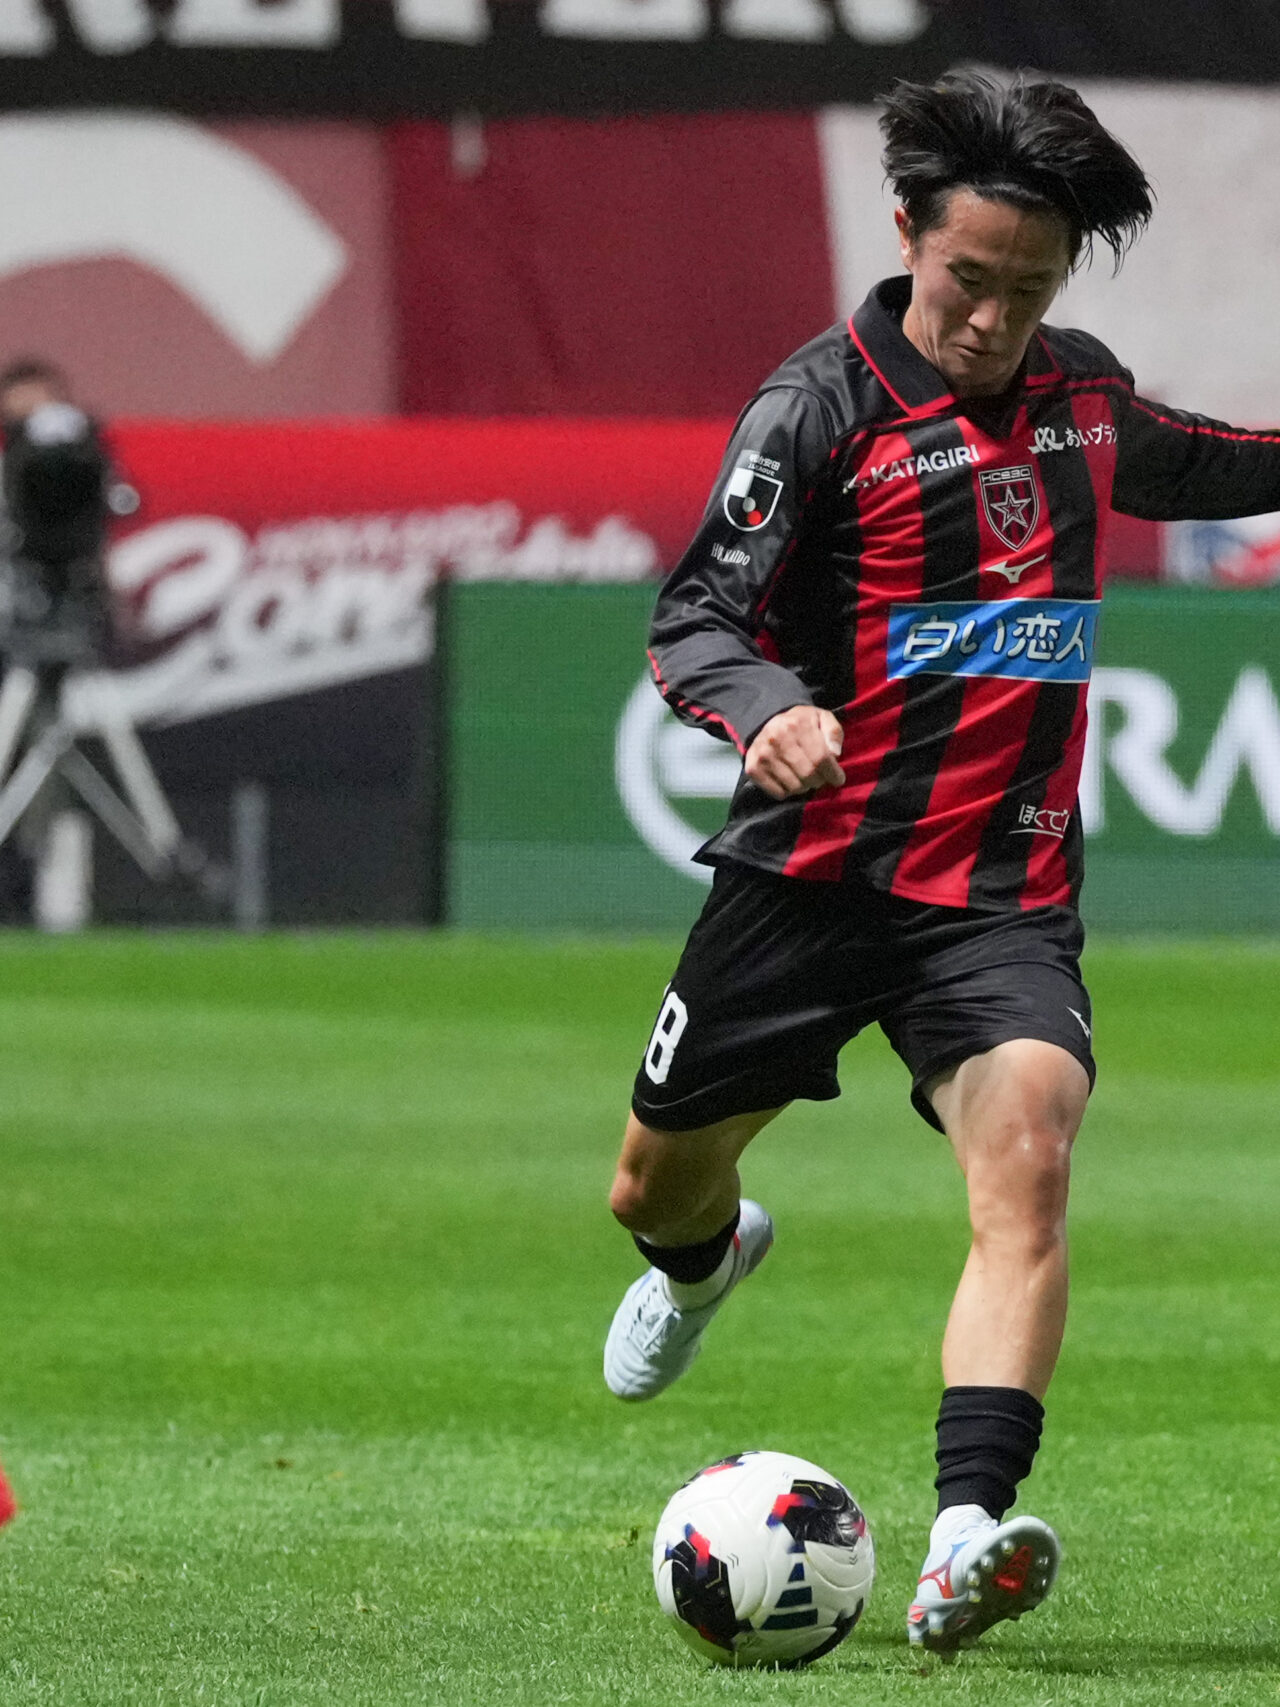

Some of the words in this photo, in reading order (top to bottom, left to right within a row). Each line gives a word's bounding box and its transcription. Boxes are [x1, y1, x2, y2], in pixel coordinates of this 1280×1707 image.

[870, 444, 981, 485] KATAGIRI
[902, 612, 1086, 663] 白い恋人
